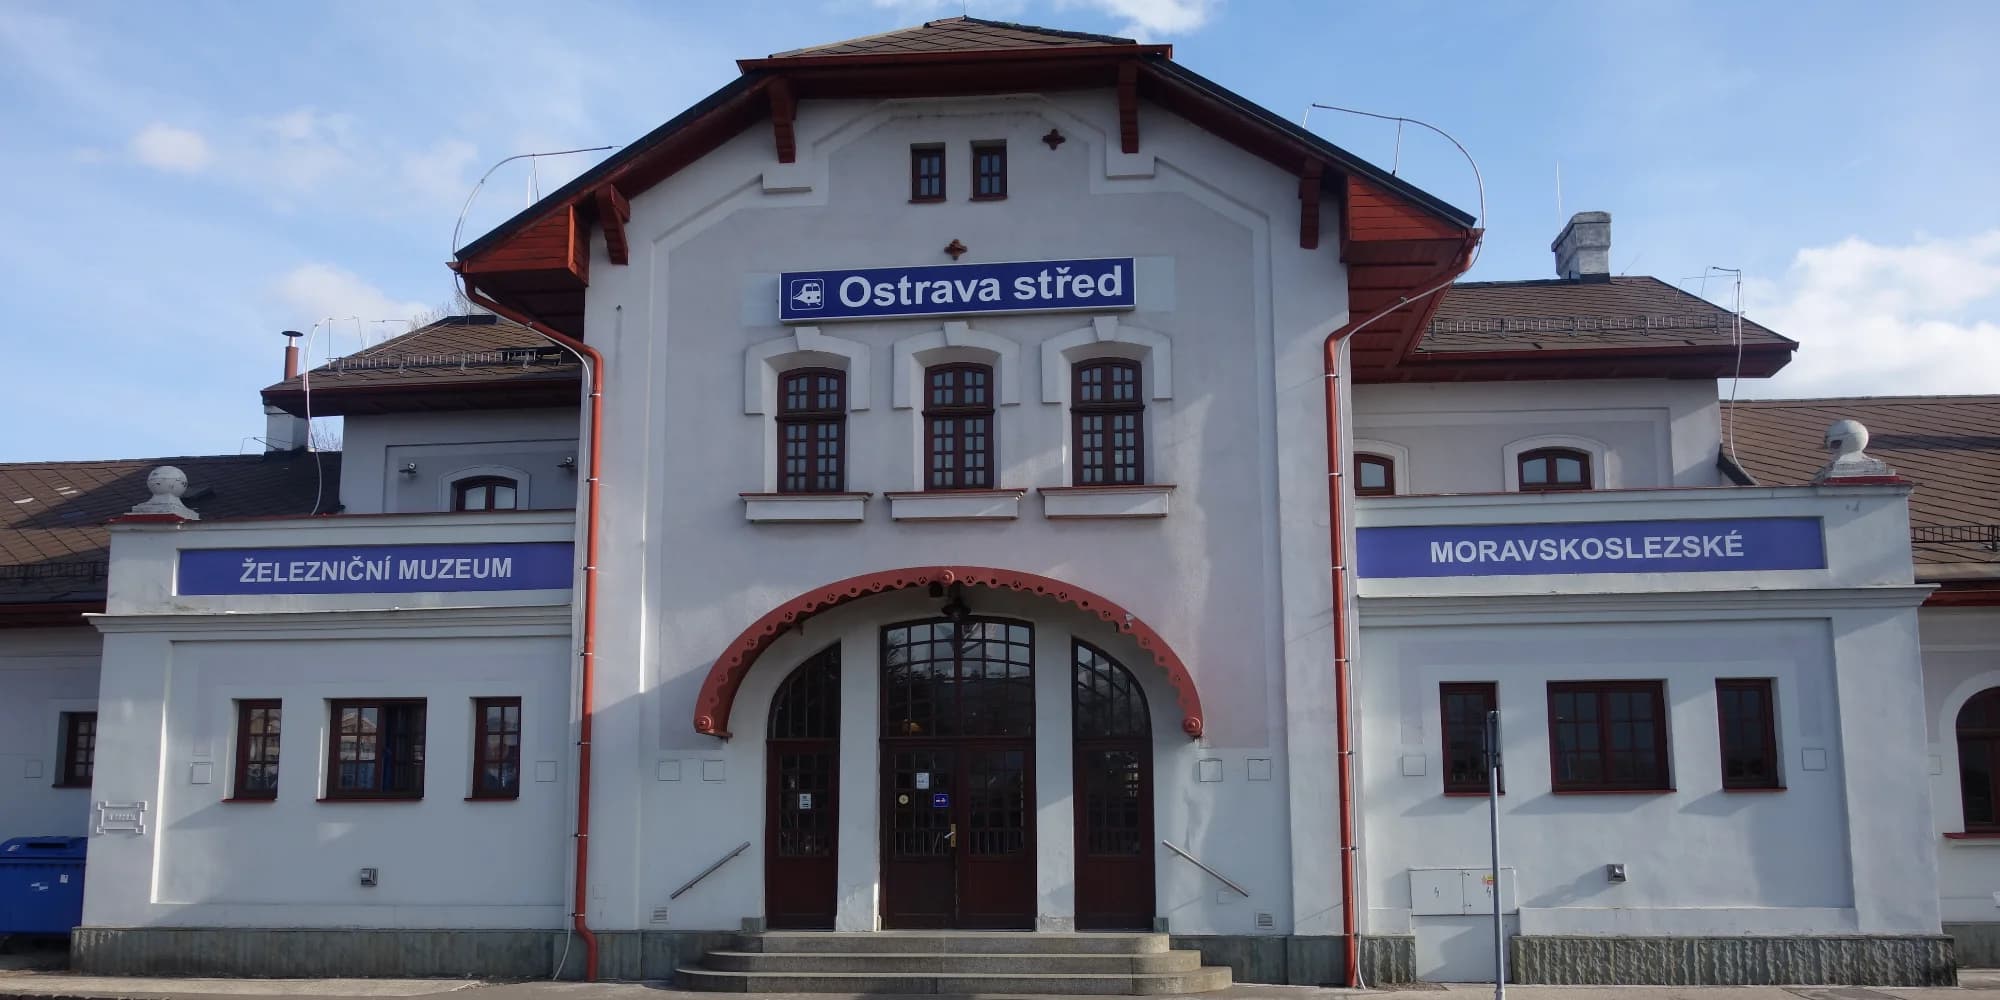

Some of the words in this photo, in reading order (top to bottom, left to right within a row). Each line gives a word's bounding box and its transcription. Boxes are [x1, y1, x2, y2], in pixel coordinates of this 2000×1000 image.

[839, 275, 1001, 308] Ostrava
[1013, 265, 1123, 300] střed
[1430, 530, 1745, 563] MORAVSKOSLEZSKÉ
[239, 555, 392, 583] ŽELEZNIČNÍ
[398, 557, 512, 580] MUZEUM
